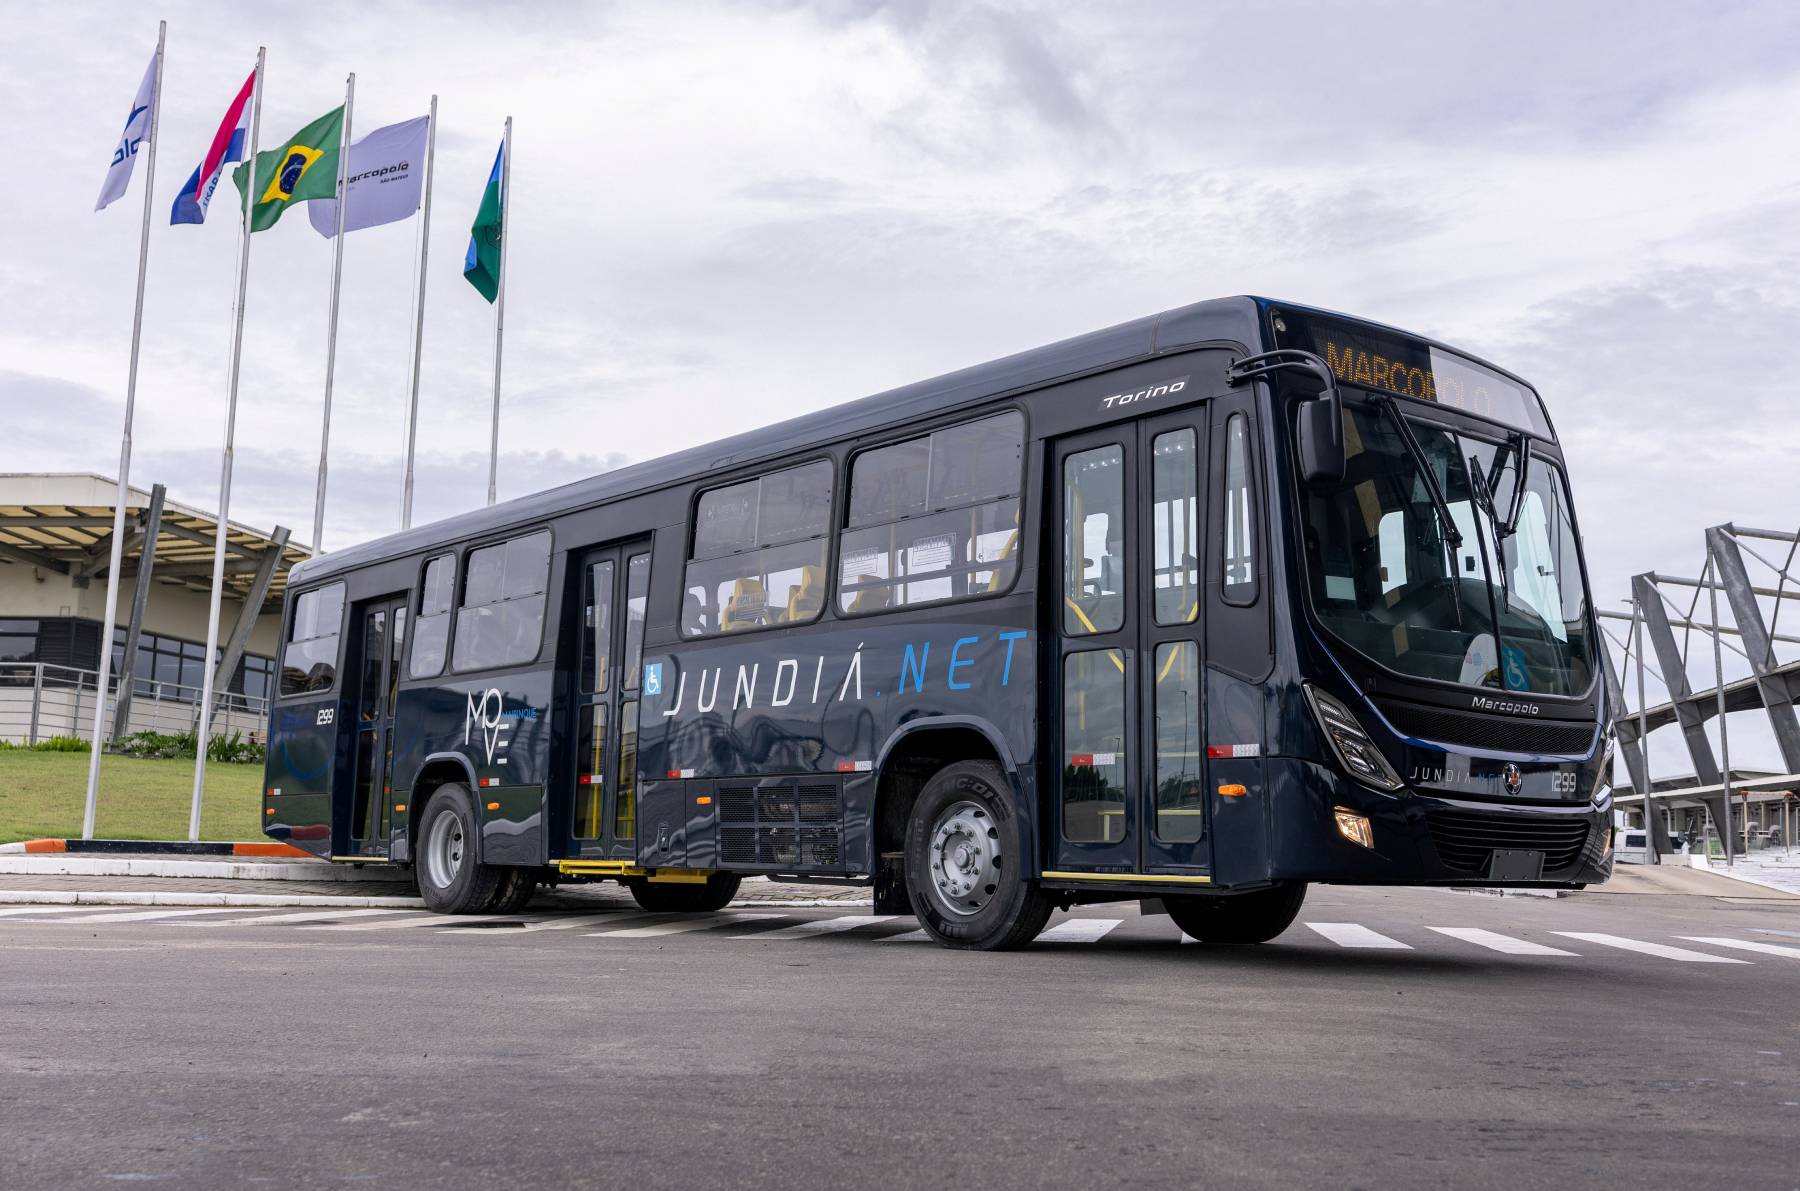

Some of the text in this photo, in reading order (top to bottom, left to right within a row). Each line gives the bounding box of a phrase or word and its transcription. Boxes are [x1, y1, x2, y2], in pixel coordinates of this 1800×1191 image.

[1103, 381, 1185, 408] Torino
[1471, 697, 1539, 714] Marcopolo
[317, 709, 334, 725] 1299
[1551, 772, 1577, 793] 1299
